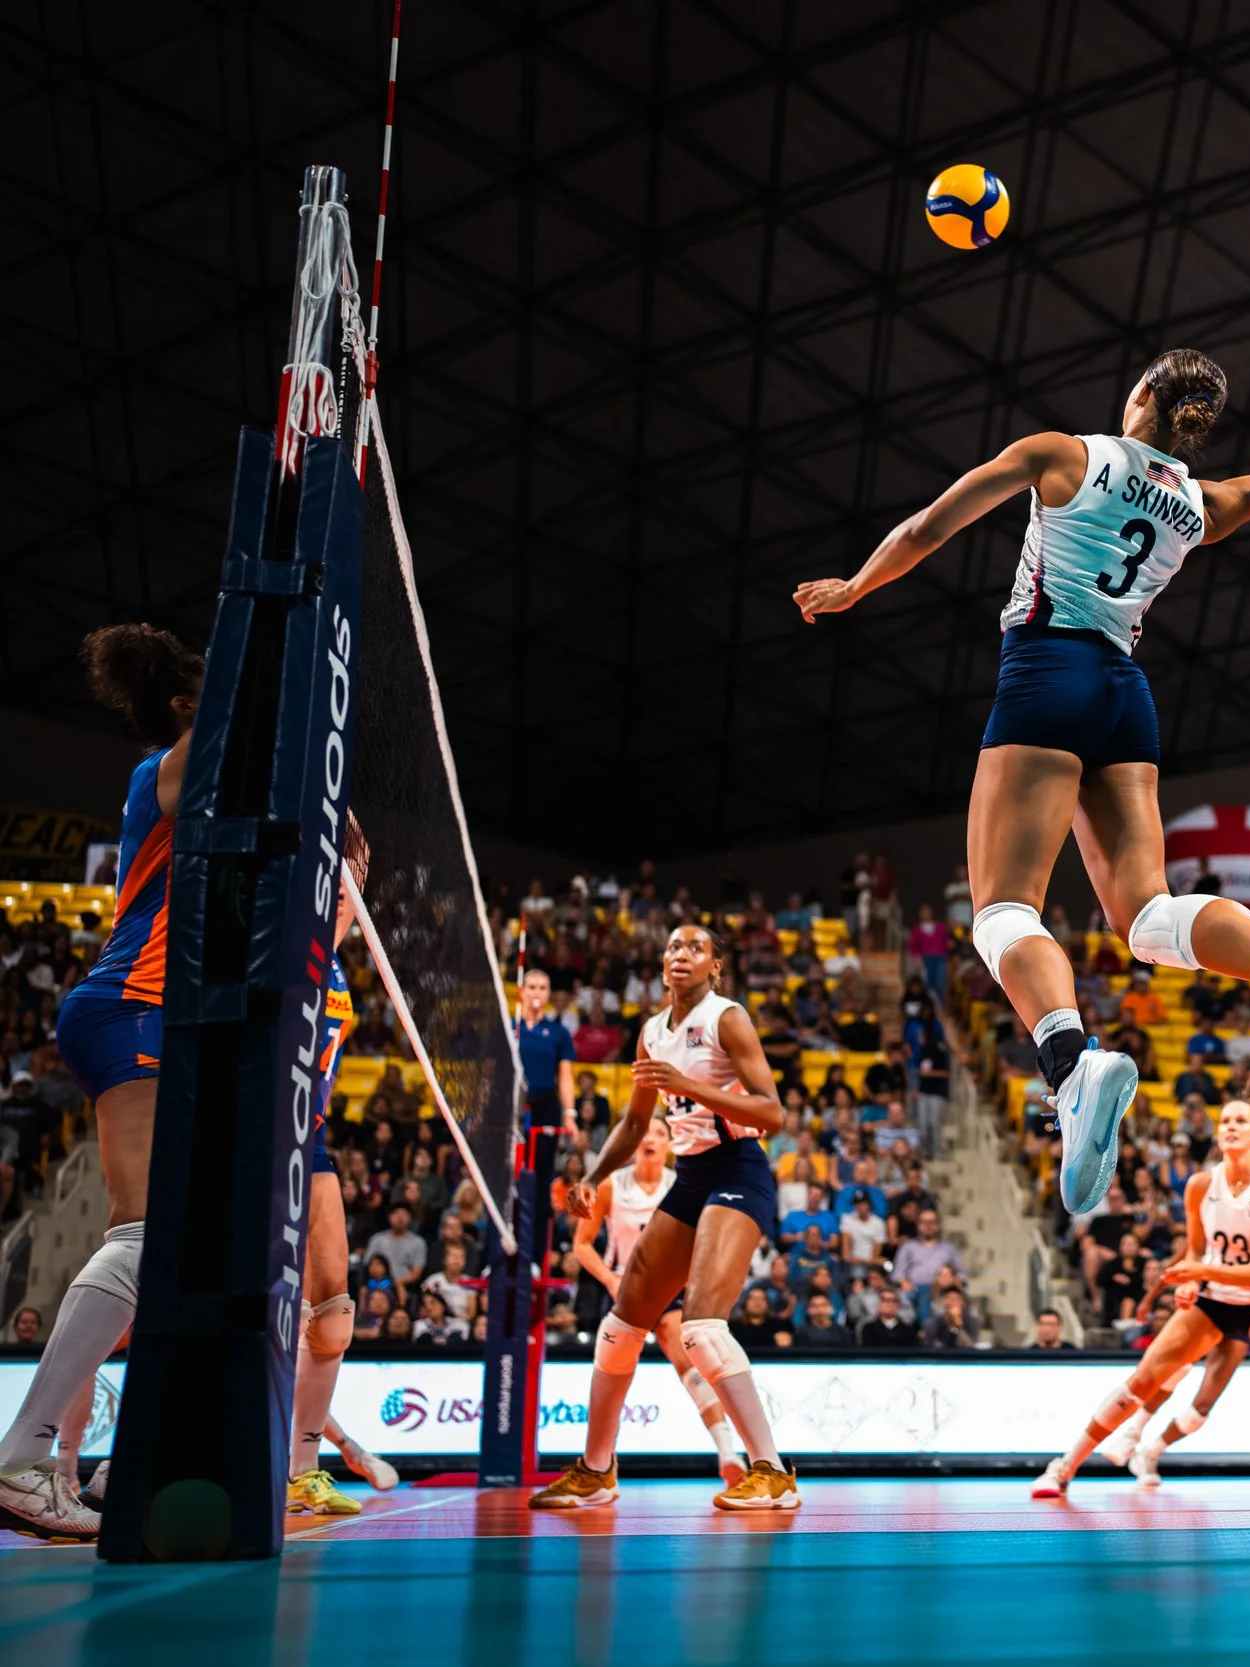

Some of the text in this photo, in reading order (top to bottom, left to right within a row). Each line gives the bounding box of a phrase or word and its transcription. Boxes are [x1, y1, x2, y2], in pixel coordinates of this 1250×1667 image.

[1092, 463, 1203, 542] A. SKINNER
[1095, 518, 1157, 598] 3
[315, 604, 351, 922] sports
